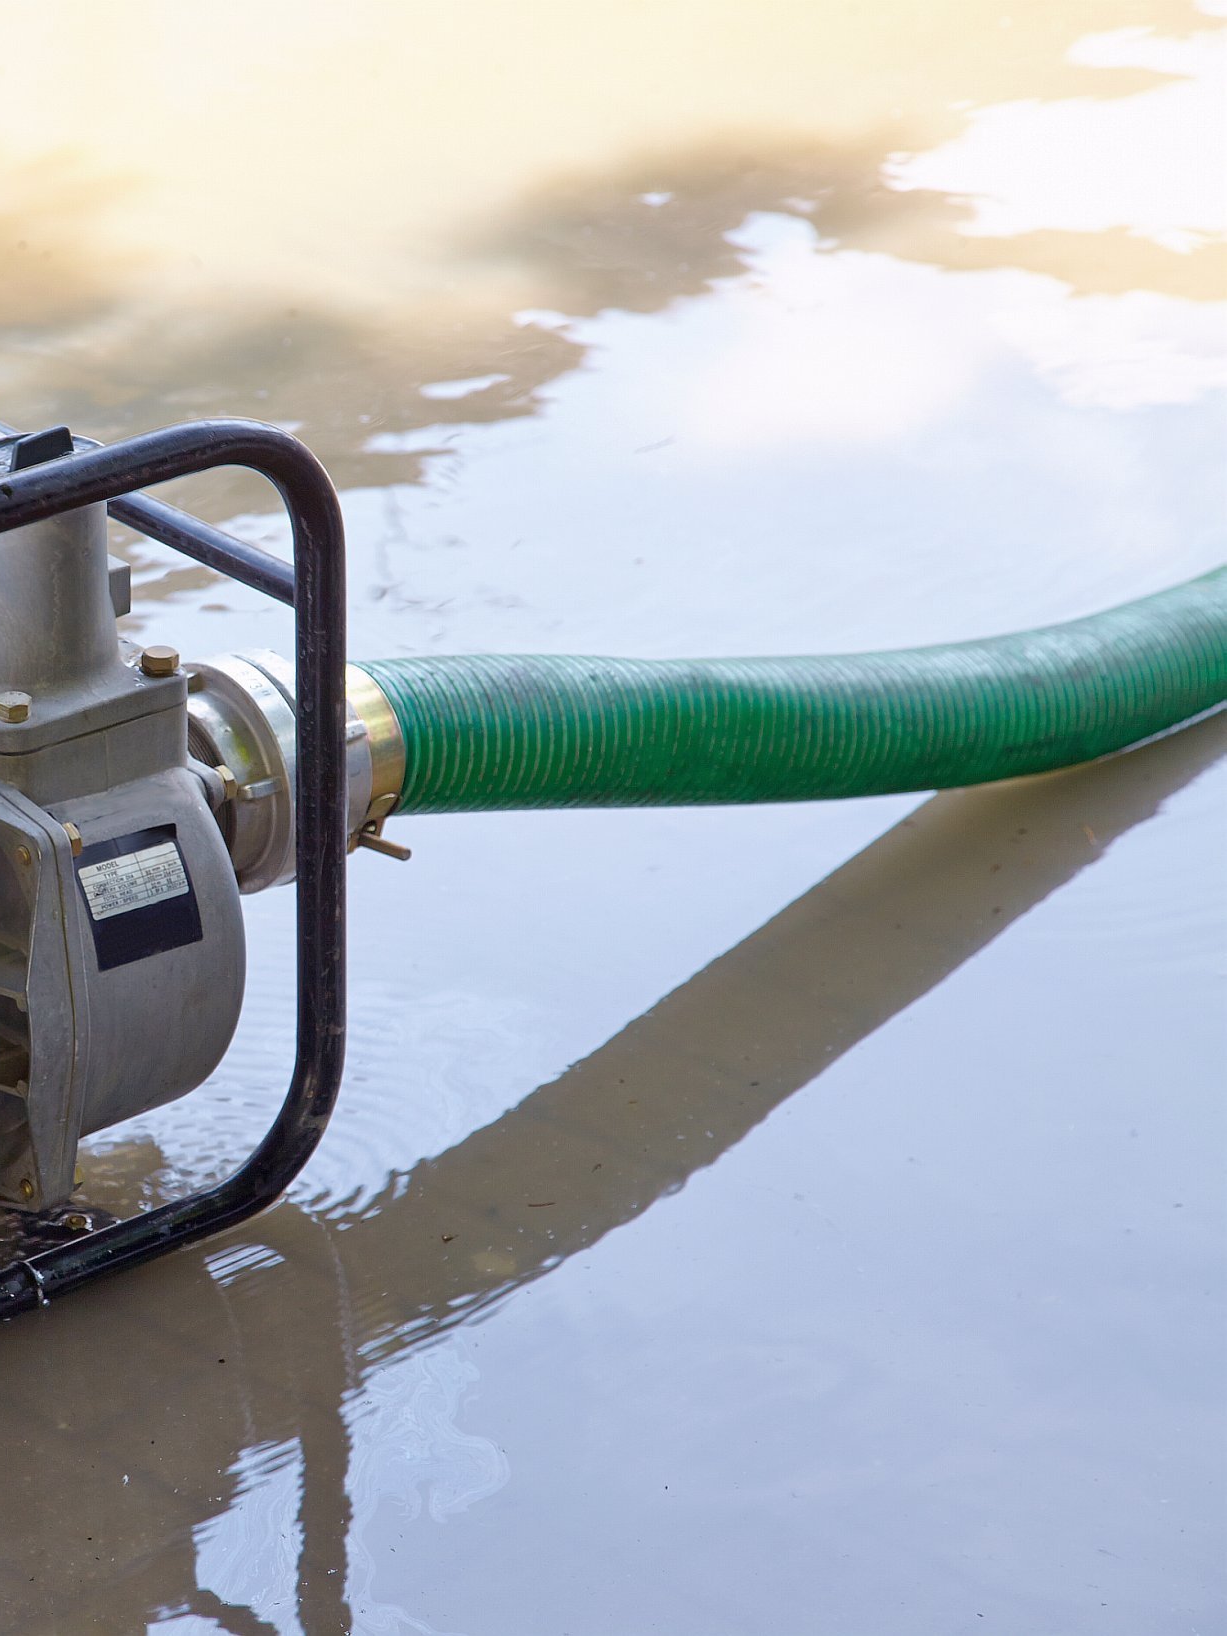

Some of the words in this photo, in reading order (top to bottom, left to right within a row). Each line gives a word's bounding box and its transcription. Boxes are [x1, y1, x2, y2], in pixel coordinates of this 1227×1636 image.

[96, 861, 119, 872] MODEL
[104, 870, 118, 879] TYPE
[103, 894, 118, 902] TOTAL
[120, 889, 133, 897] HEAD
[101, 901, 119, 910] POWER
[123, 895, 139, 903] SPEED
